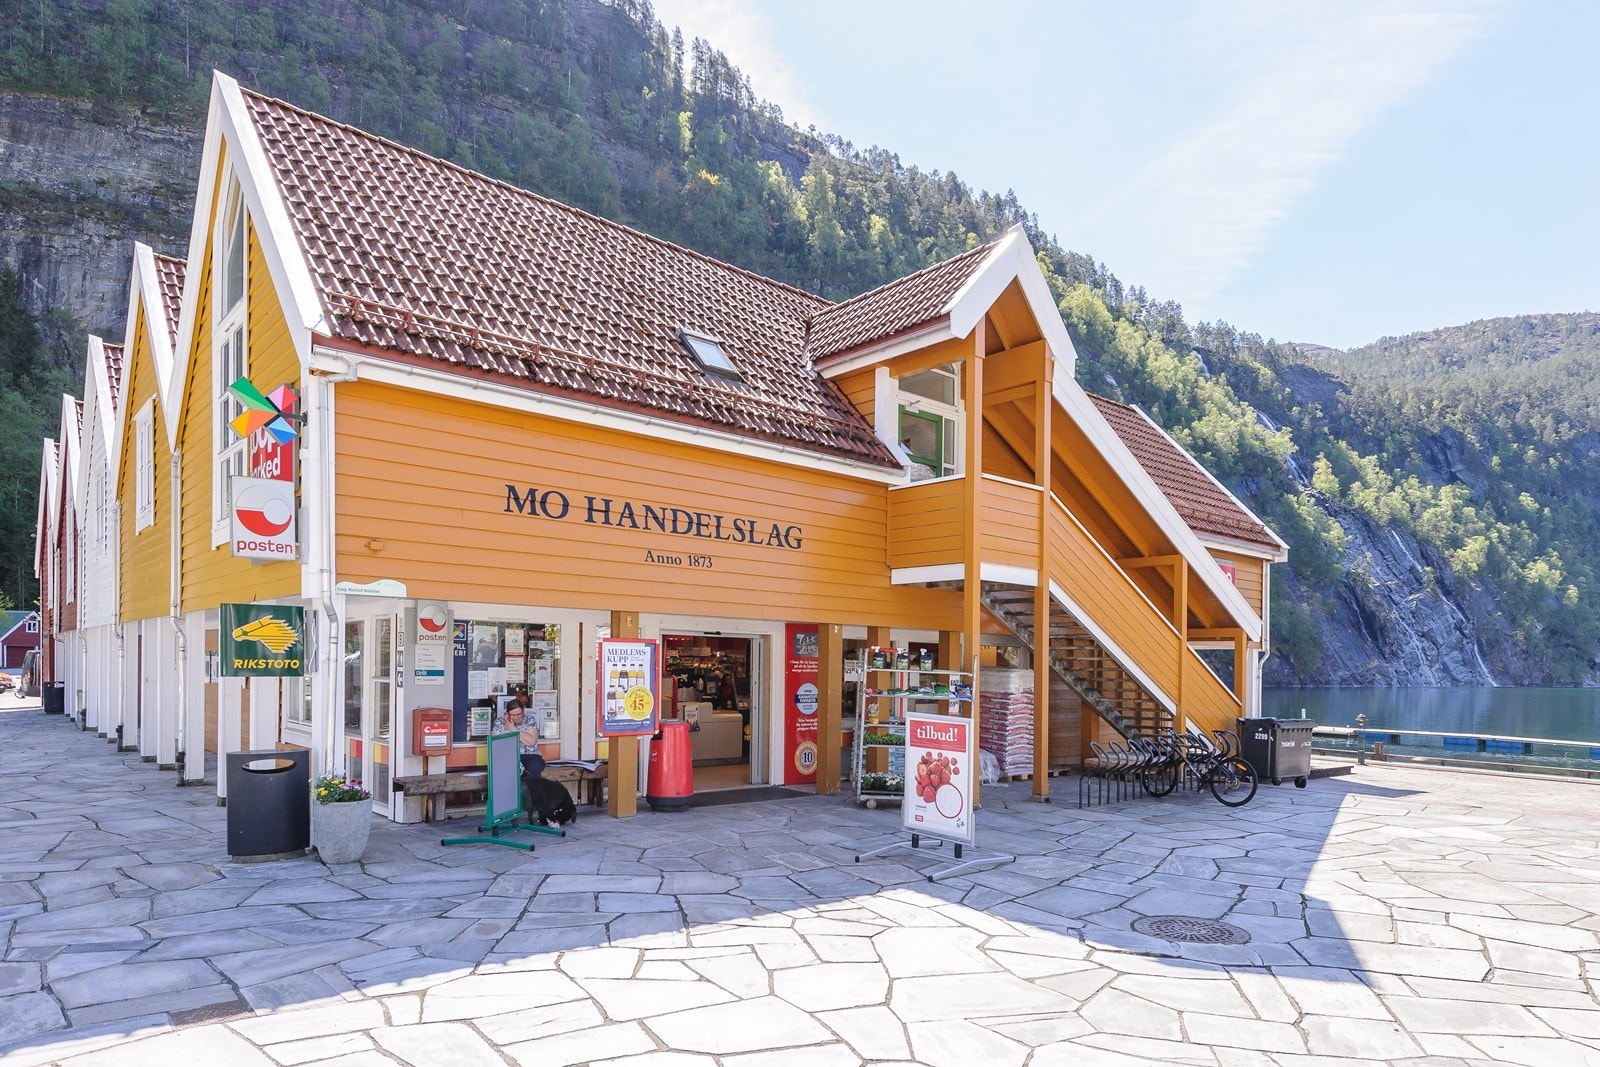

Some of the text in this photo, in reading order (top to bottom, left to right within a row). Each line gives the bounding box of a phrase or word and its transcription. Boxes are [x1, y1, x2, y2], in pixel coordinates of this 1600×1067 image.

[503, 484, 803, 550] MO HANDELSLAG
[236, 540, 293, 554] posten
[644, 550, 713, 569] Anno 1873
[418, 633, 447, 641] posten
[233, 659, 300, 669] RIKSTOTO
[607, 655, 629, 663] KUPP
[630, 699, 645, 711] 45
[916, 725, 958, 742] tilbud!
[803, 751, 813, 762] 10
